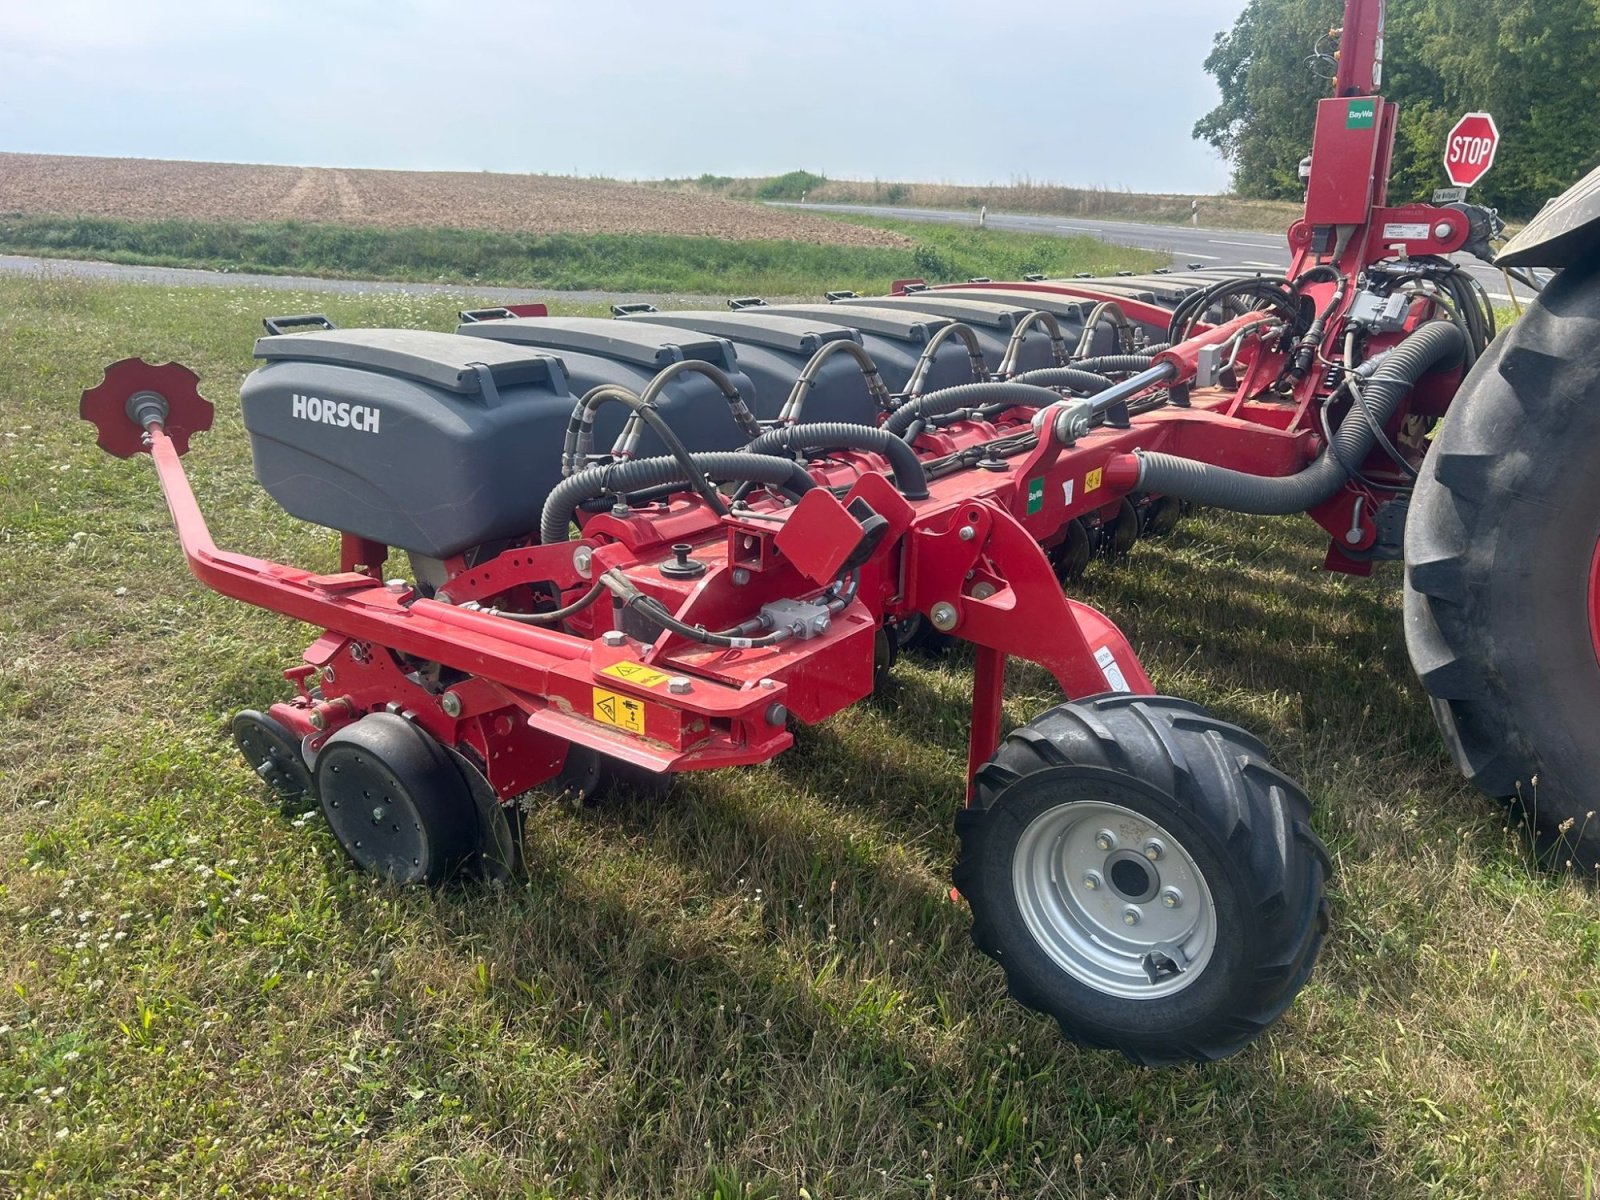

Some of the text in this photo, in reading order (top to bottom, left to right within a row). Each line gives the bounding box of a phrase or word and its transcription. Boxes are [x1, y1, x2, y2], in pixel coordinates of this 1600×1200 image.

[1348, 110, 1373, 119] BayWa
[1450, 135, 1492, 165] STOP
[292, 393, 380, 434] HORSCH
